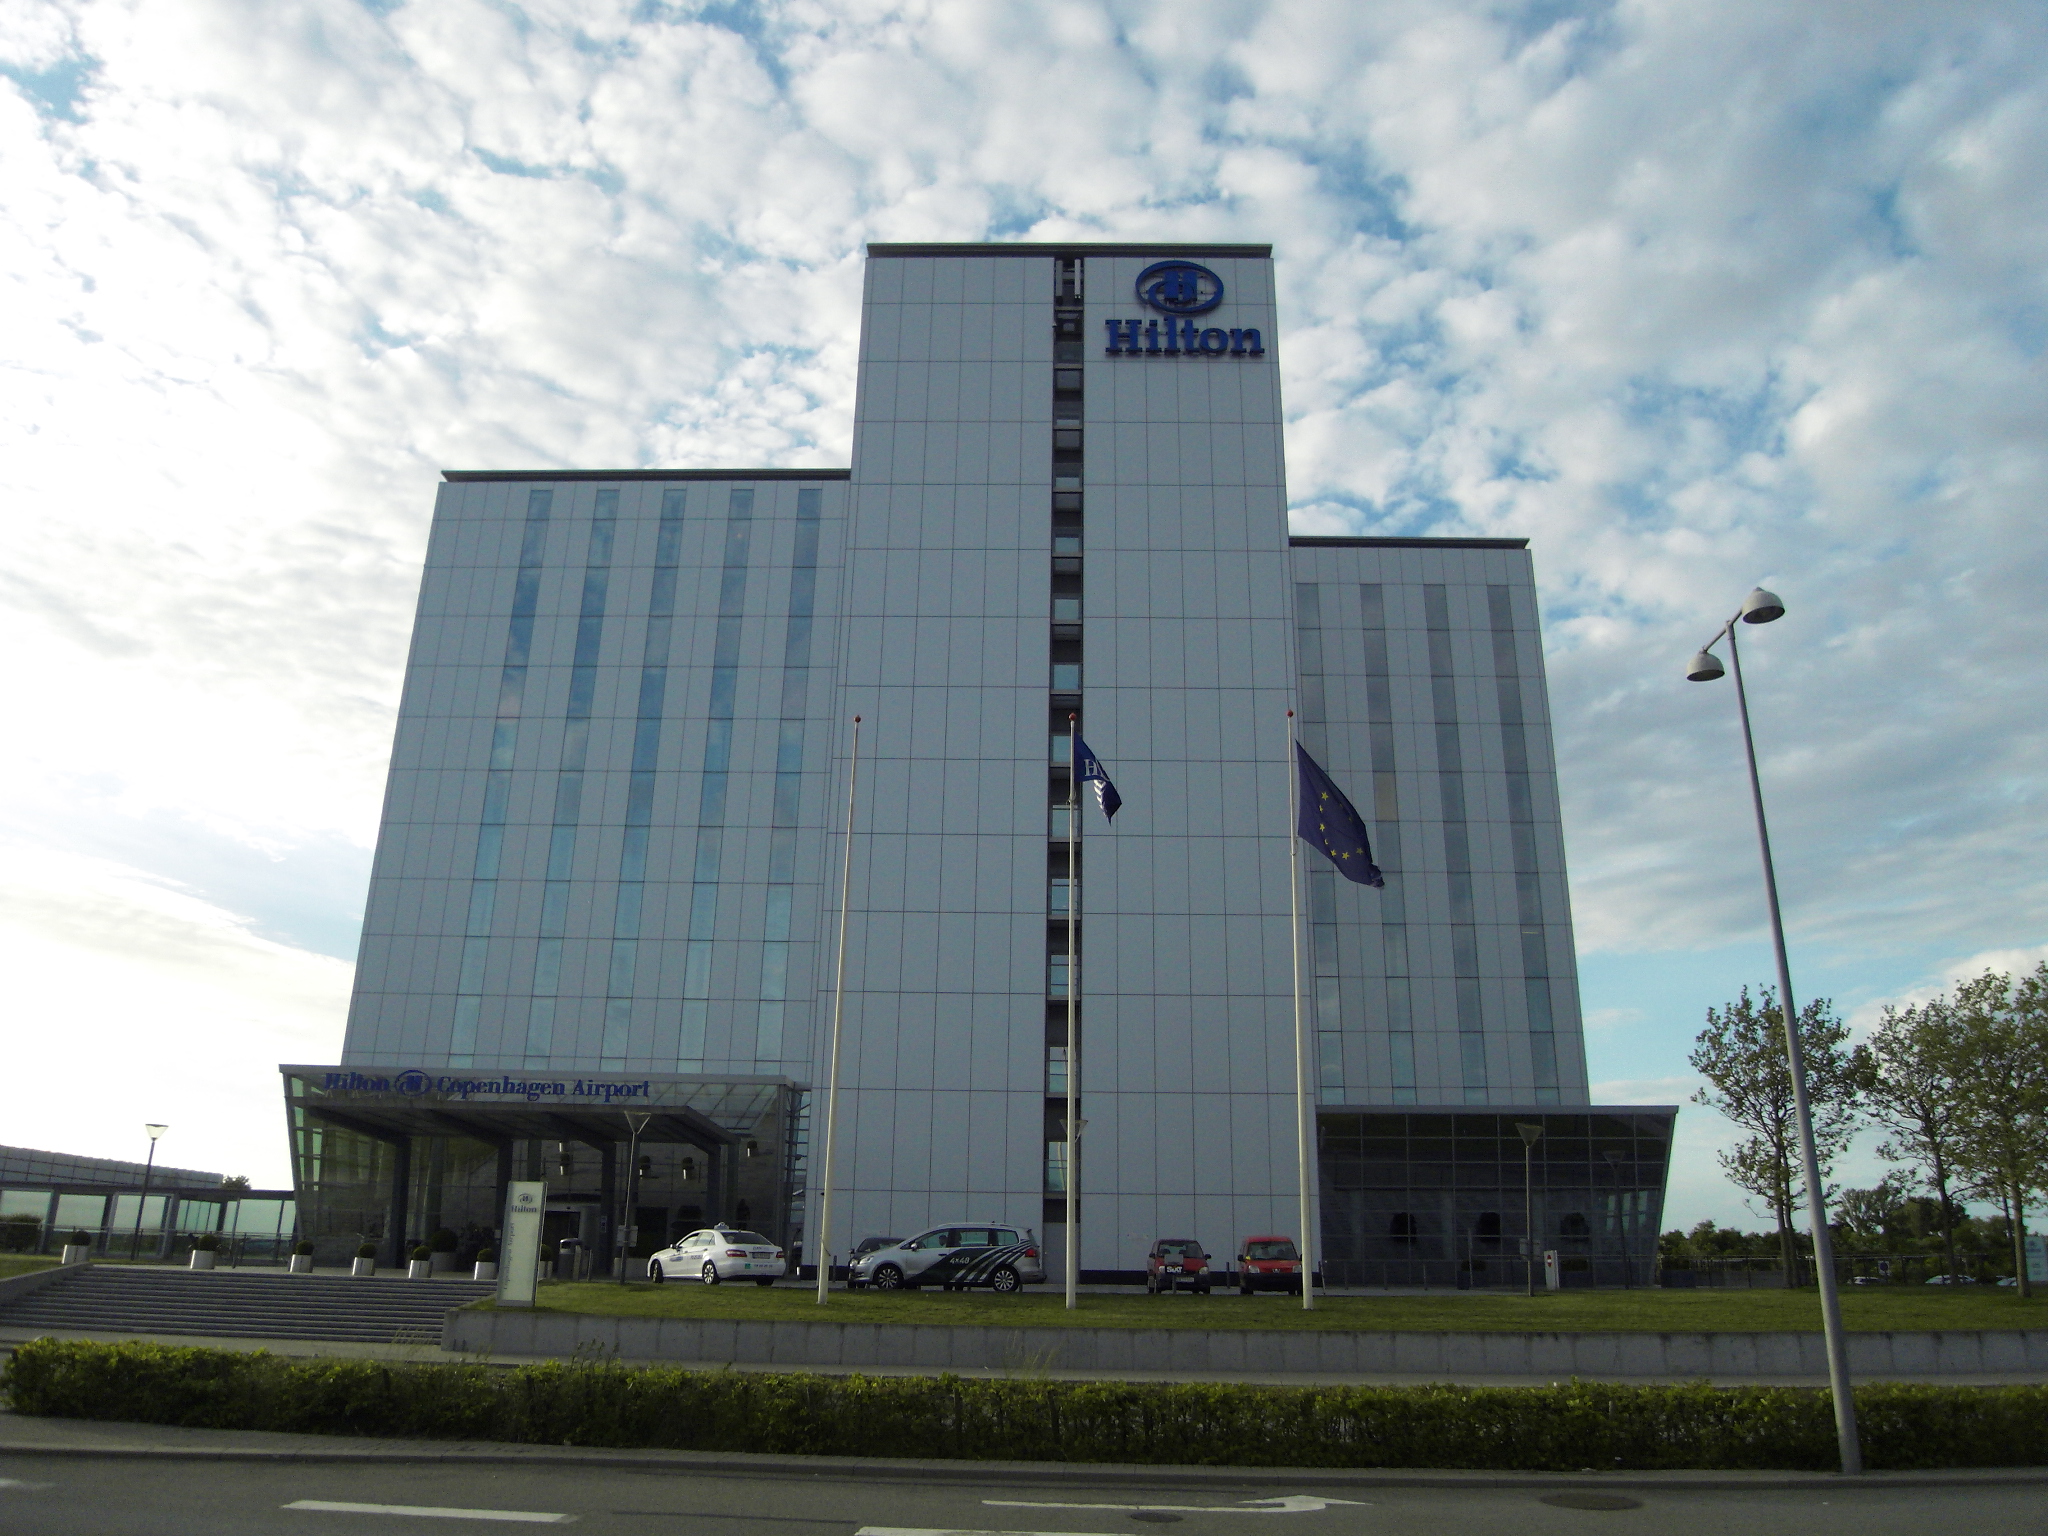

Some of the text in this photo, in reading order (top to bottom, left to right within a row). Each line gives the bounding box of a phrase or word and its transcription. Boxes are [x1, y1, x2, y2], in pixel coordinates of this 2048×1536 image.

[1105, 315, 1265, 354] Hilton
[324, 1072, 390, 1091] Hilton
[437, 1076, 566, 1101] Copenhagen
[572, 1079, 649, 1102] Airport
[511, 1204, 537, 1213] Hilton
